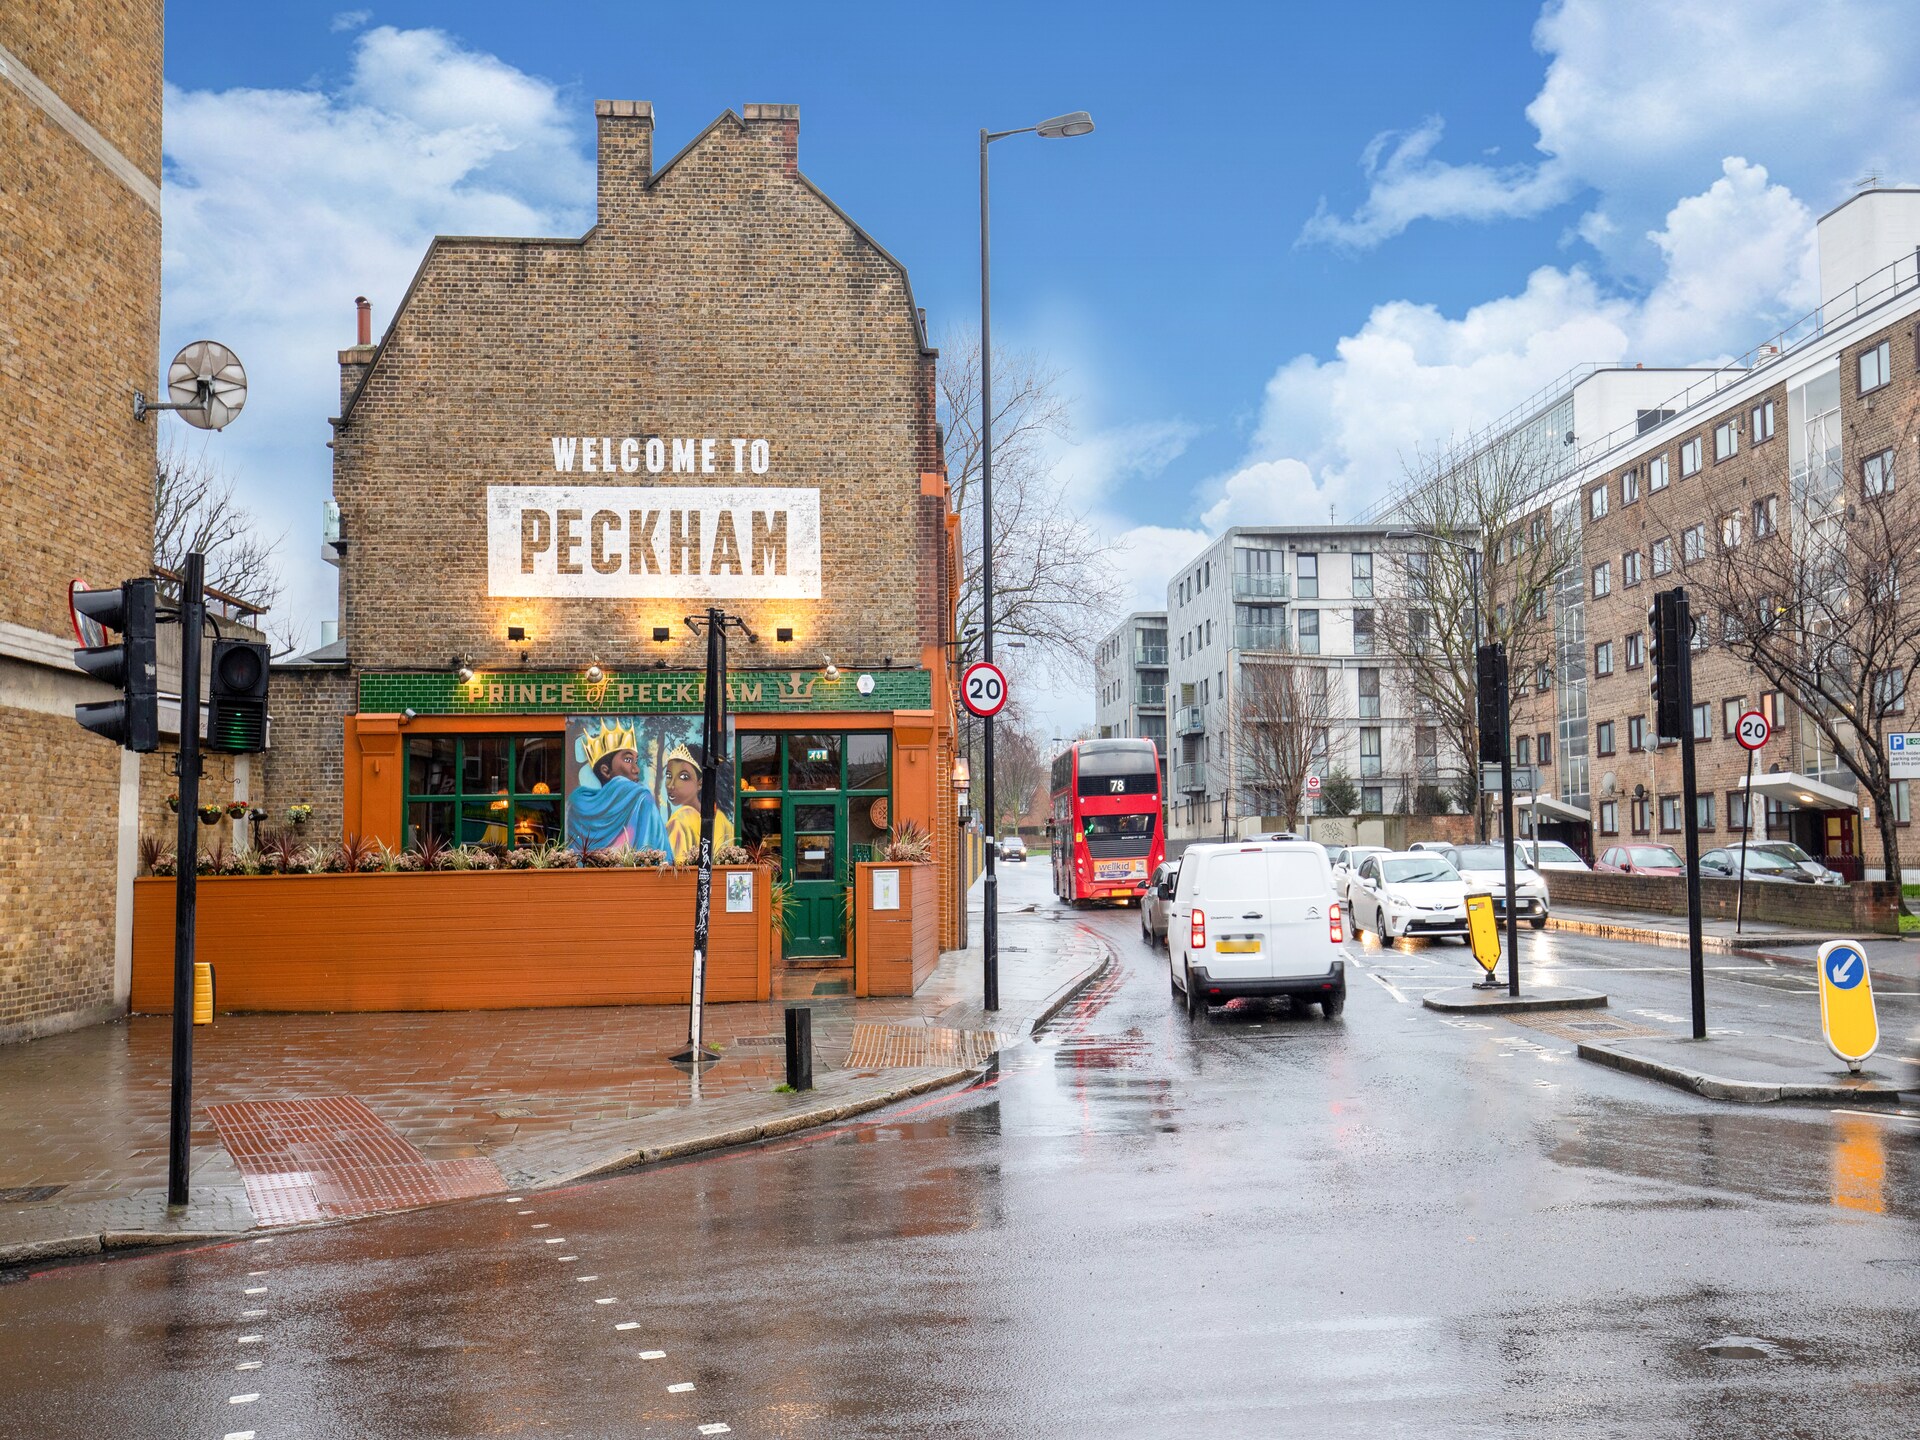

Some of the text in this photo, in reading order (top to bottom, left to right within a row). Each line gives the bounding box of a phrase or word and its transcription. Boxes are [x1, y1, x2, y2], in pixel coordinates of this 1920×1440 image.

[552, 437, 770, 474] WELCOME TO
[521, 509, 787, 576] PECKHAM
[468, 684, 575, 704] PRINCE
[586, 678, 613, 710] of
[969, 678, 1001, 700] 20
[1742, 721, 1766, 739] 20
[1893, 736, 1903, 750] P
[1110, 780, 1125, 792] 78
[1098, 861, 1130, 871] wellkid
